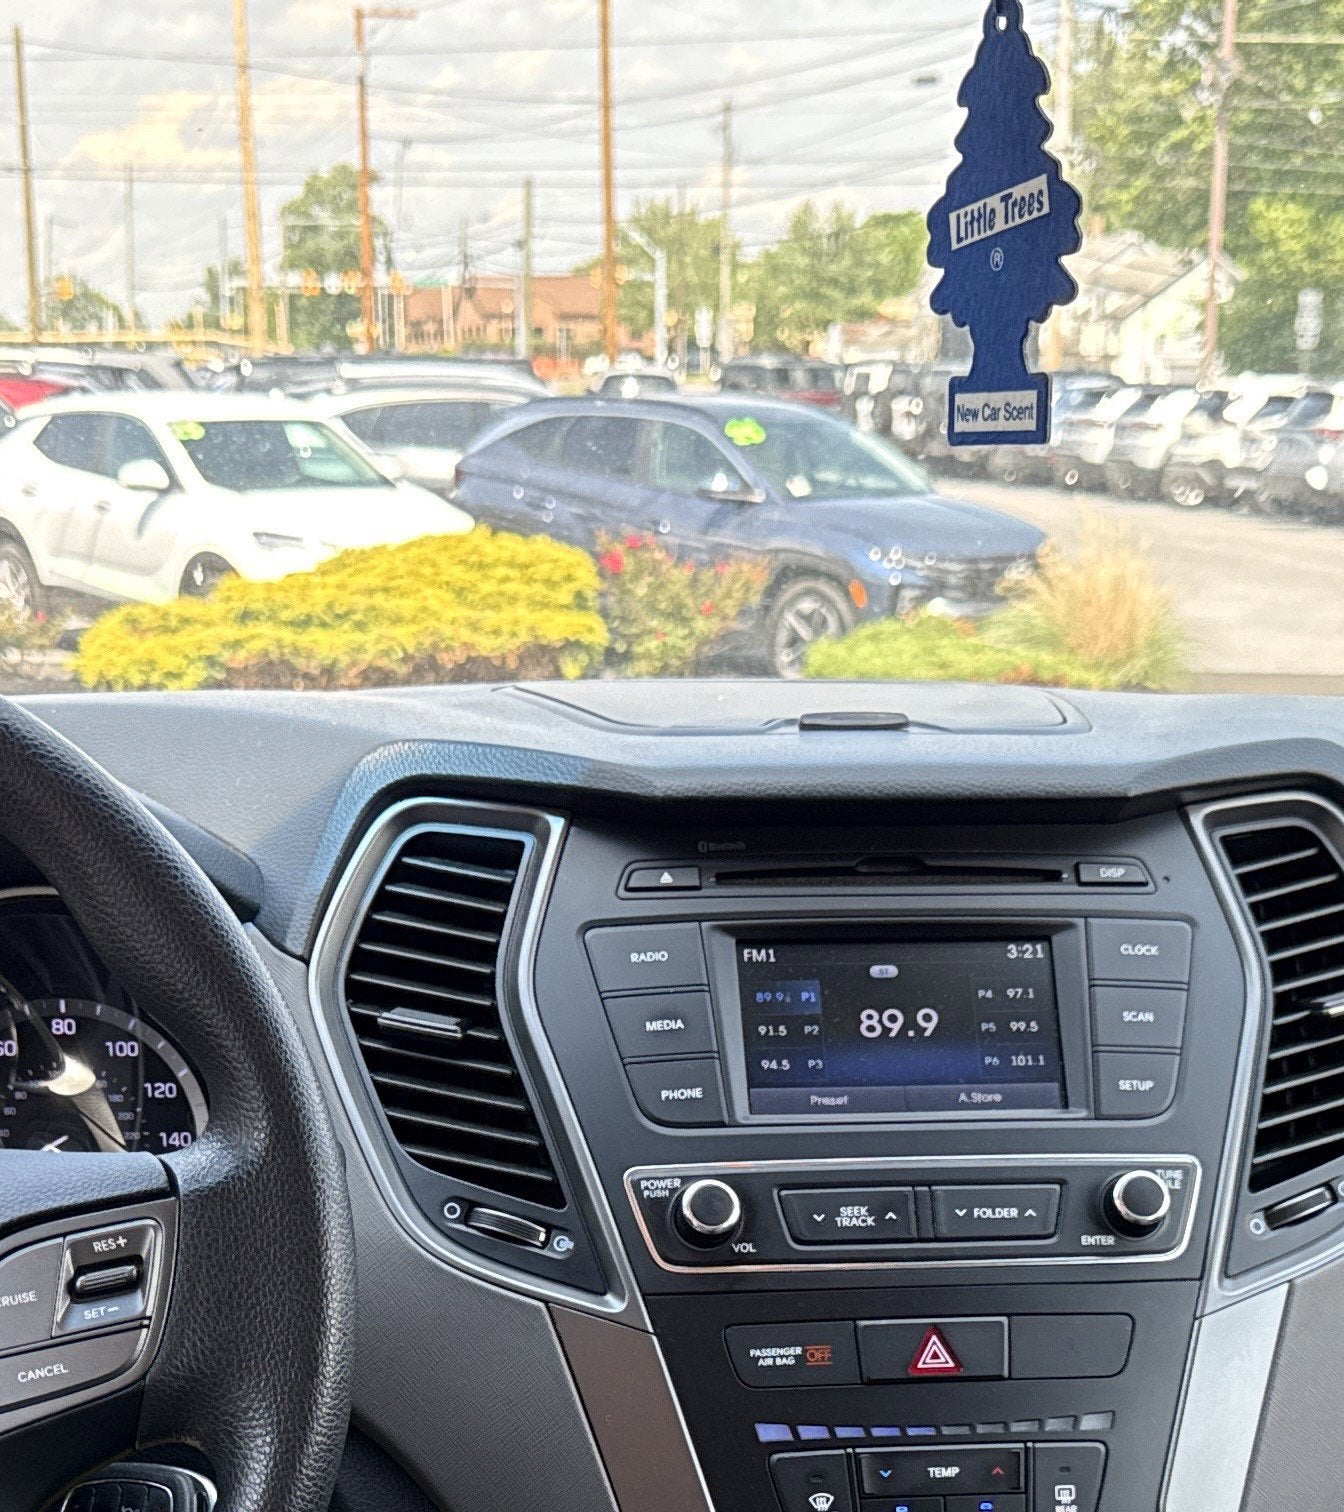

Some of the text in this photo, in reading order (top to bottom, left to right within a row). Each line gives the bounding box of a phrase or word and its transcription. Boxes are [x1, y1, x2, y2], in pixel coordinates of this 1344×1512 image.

[956, 189, 1045, 245] Little Trees
[956, 402, 1034, 423] New Car Scent
[1098, 867, 1126, 879] DISP
[743, 948, 777, 963] FM1
[1006, 943, 1045, 959] 3:21
[1120, 943, 1159, 956] CLOCK
[630, 951, 669, 963] RADIO
[800, 991, 816, 1003] P1
[977, 988, 1035, 999] P4 97.1
[1122, 1010, 1155, 1023] SCAN
[51, 1018, 77, 1036] 80
[645, 1018, 685, 1032] MEDIA
[859, 1007, 939, 1039] 89.9
[1009, 1021, 1039, 1032] 99.5
[758, 1025, 820, 1037] 91.5 P2
[105, 1041, 139, 1057] 100
[760, 1059, 824, 1071] 94.5 P3
[984, 1054, 1045, 1066] P6 101.1
[143, 1082, 177, 1099] 120
[1118, 1079, 1155, 1091] SETUP
[661, 1087, 704, 1102] PHONE
[810, 1094, 849, 1106] Preset
[159, 1132, 192, 1148] 140
[640, 1177, 682, 1191] POWER
[643, 1188, 670, 1199] PUSH
[839, 1206, 869, 1217] SEEK
[973, 1207, 1019, 1219] FOLDER
[835, 1216, 876, 1228] TRACK
[1080, 1235, 1116, 1246] ENTER
[732, 1243, 757, 1254] VOL
[749, 1346, 803, 1358] PASSENGER
[757, 1356, 796, 1367] AIR BAG
[17, 1362, 69, 1384] CANCEL
[927, 1466, 960, 1478] TEMP
